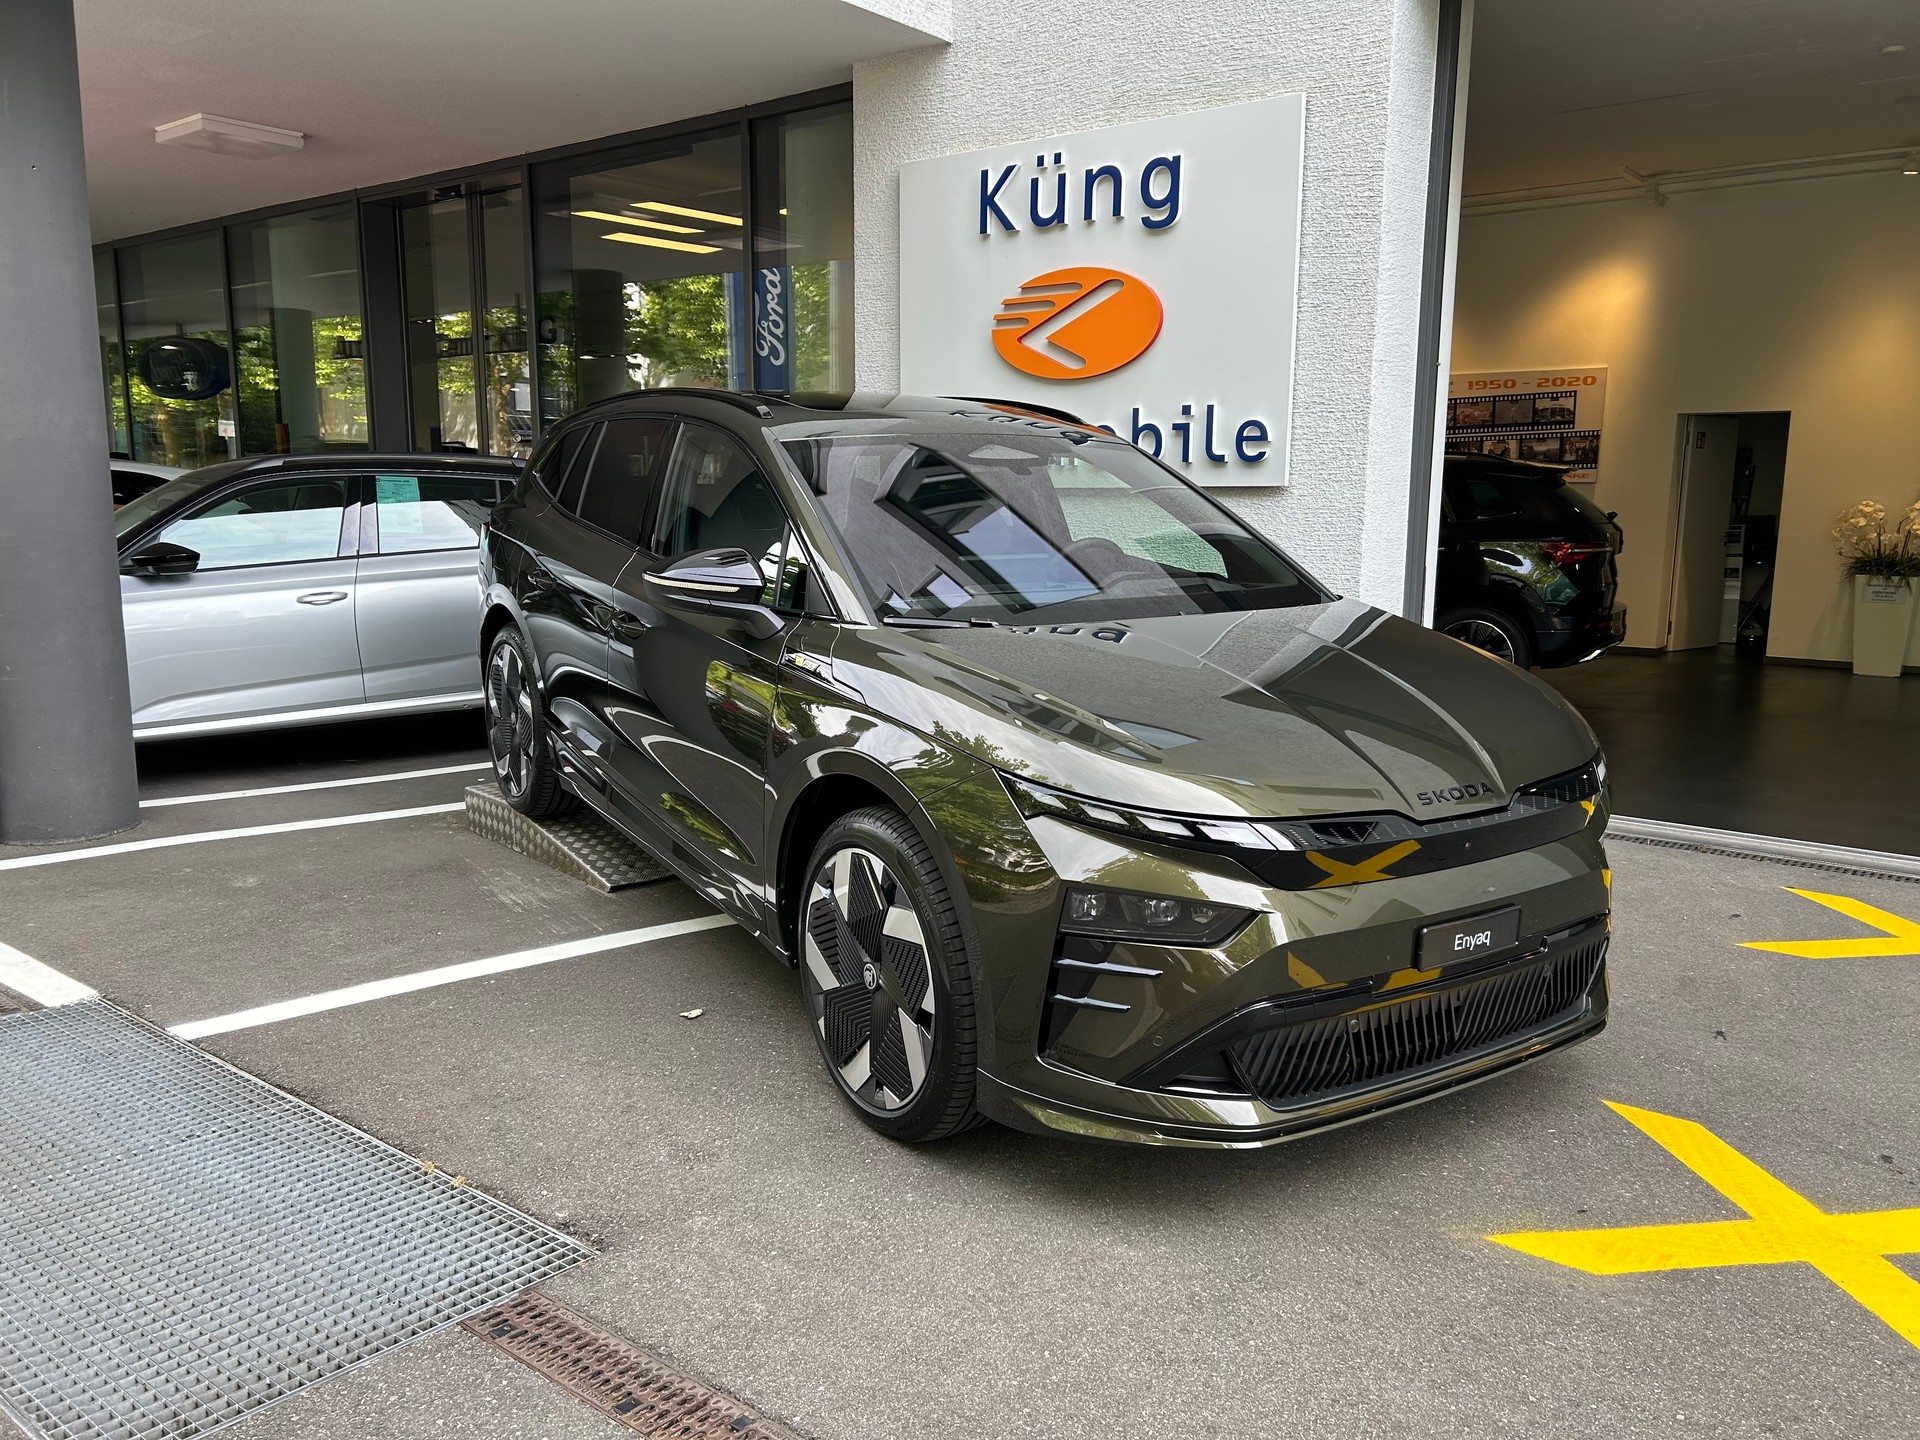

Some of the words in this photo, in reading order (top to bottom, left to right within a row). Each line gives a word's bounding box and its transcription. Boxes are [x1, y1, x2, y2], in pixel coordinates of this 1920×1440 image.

[979, 151, 1183, 235] Küng
[754, 267, 785, 366] Ford
[1467, 378, 1517, 391] 1950
[1536, 375, 1597, 388] 2020
[1097, 404, 1269, 463] bile
[1454, 930, 1491, 951] Enyaq
